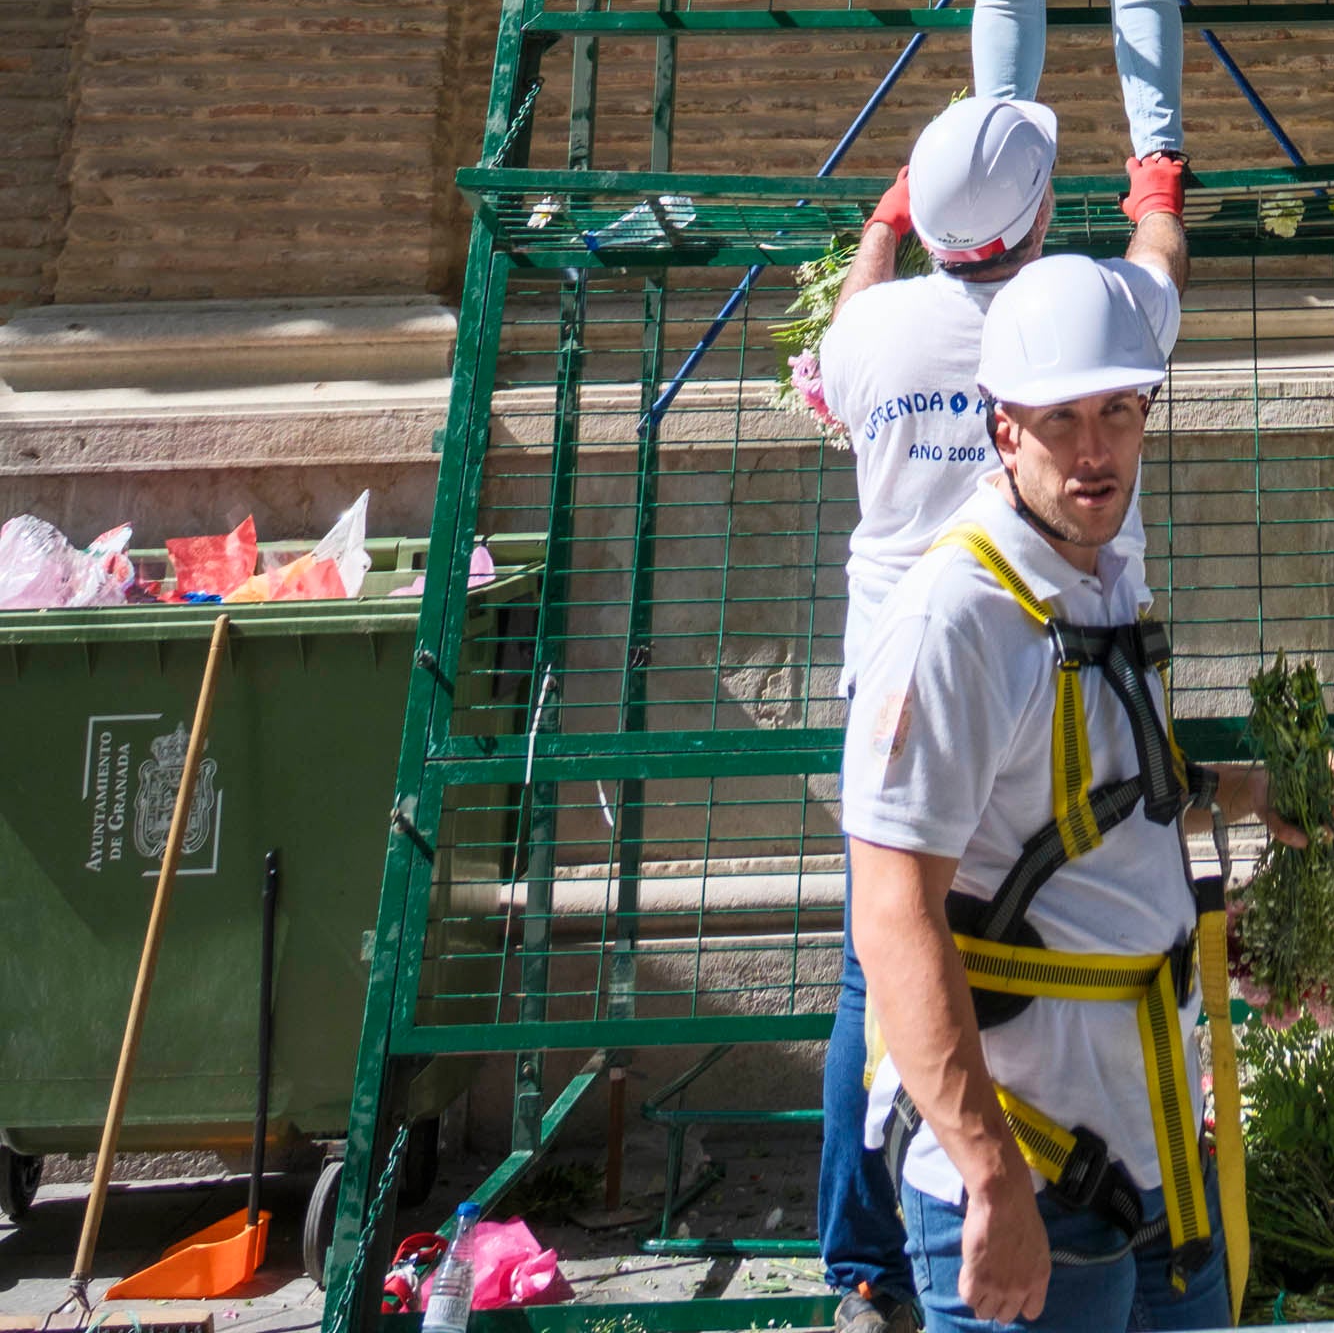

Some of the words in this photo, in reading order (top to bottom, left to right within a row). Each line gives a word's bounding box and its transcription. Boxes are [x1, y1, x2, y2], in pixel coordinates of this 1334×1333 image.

[864, 391, 945, 441] OFRENDA
[908, 440, 943, 462] AÑO
[948, 446, 986, 462] 2008
[86, 732, 112, 872] AYUNTAMIENTO
[108, 742, 130, 831] GRANADA
[109, 836, 123, 860] DE
